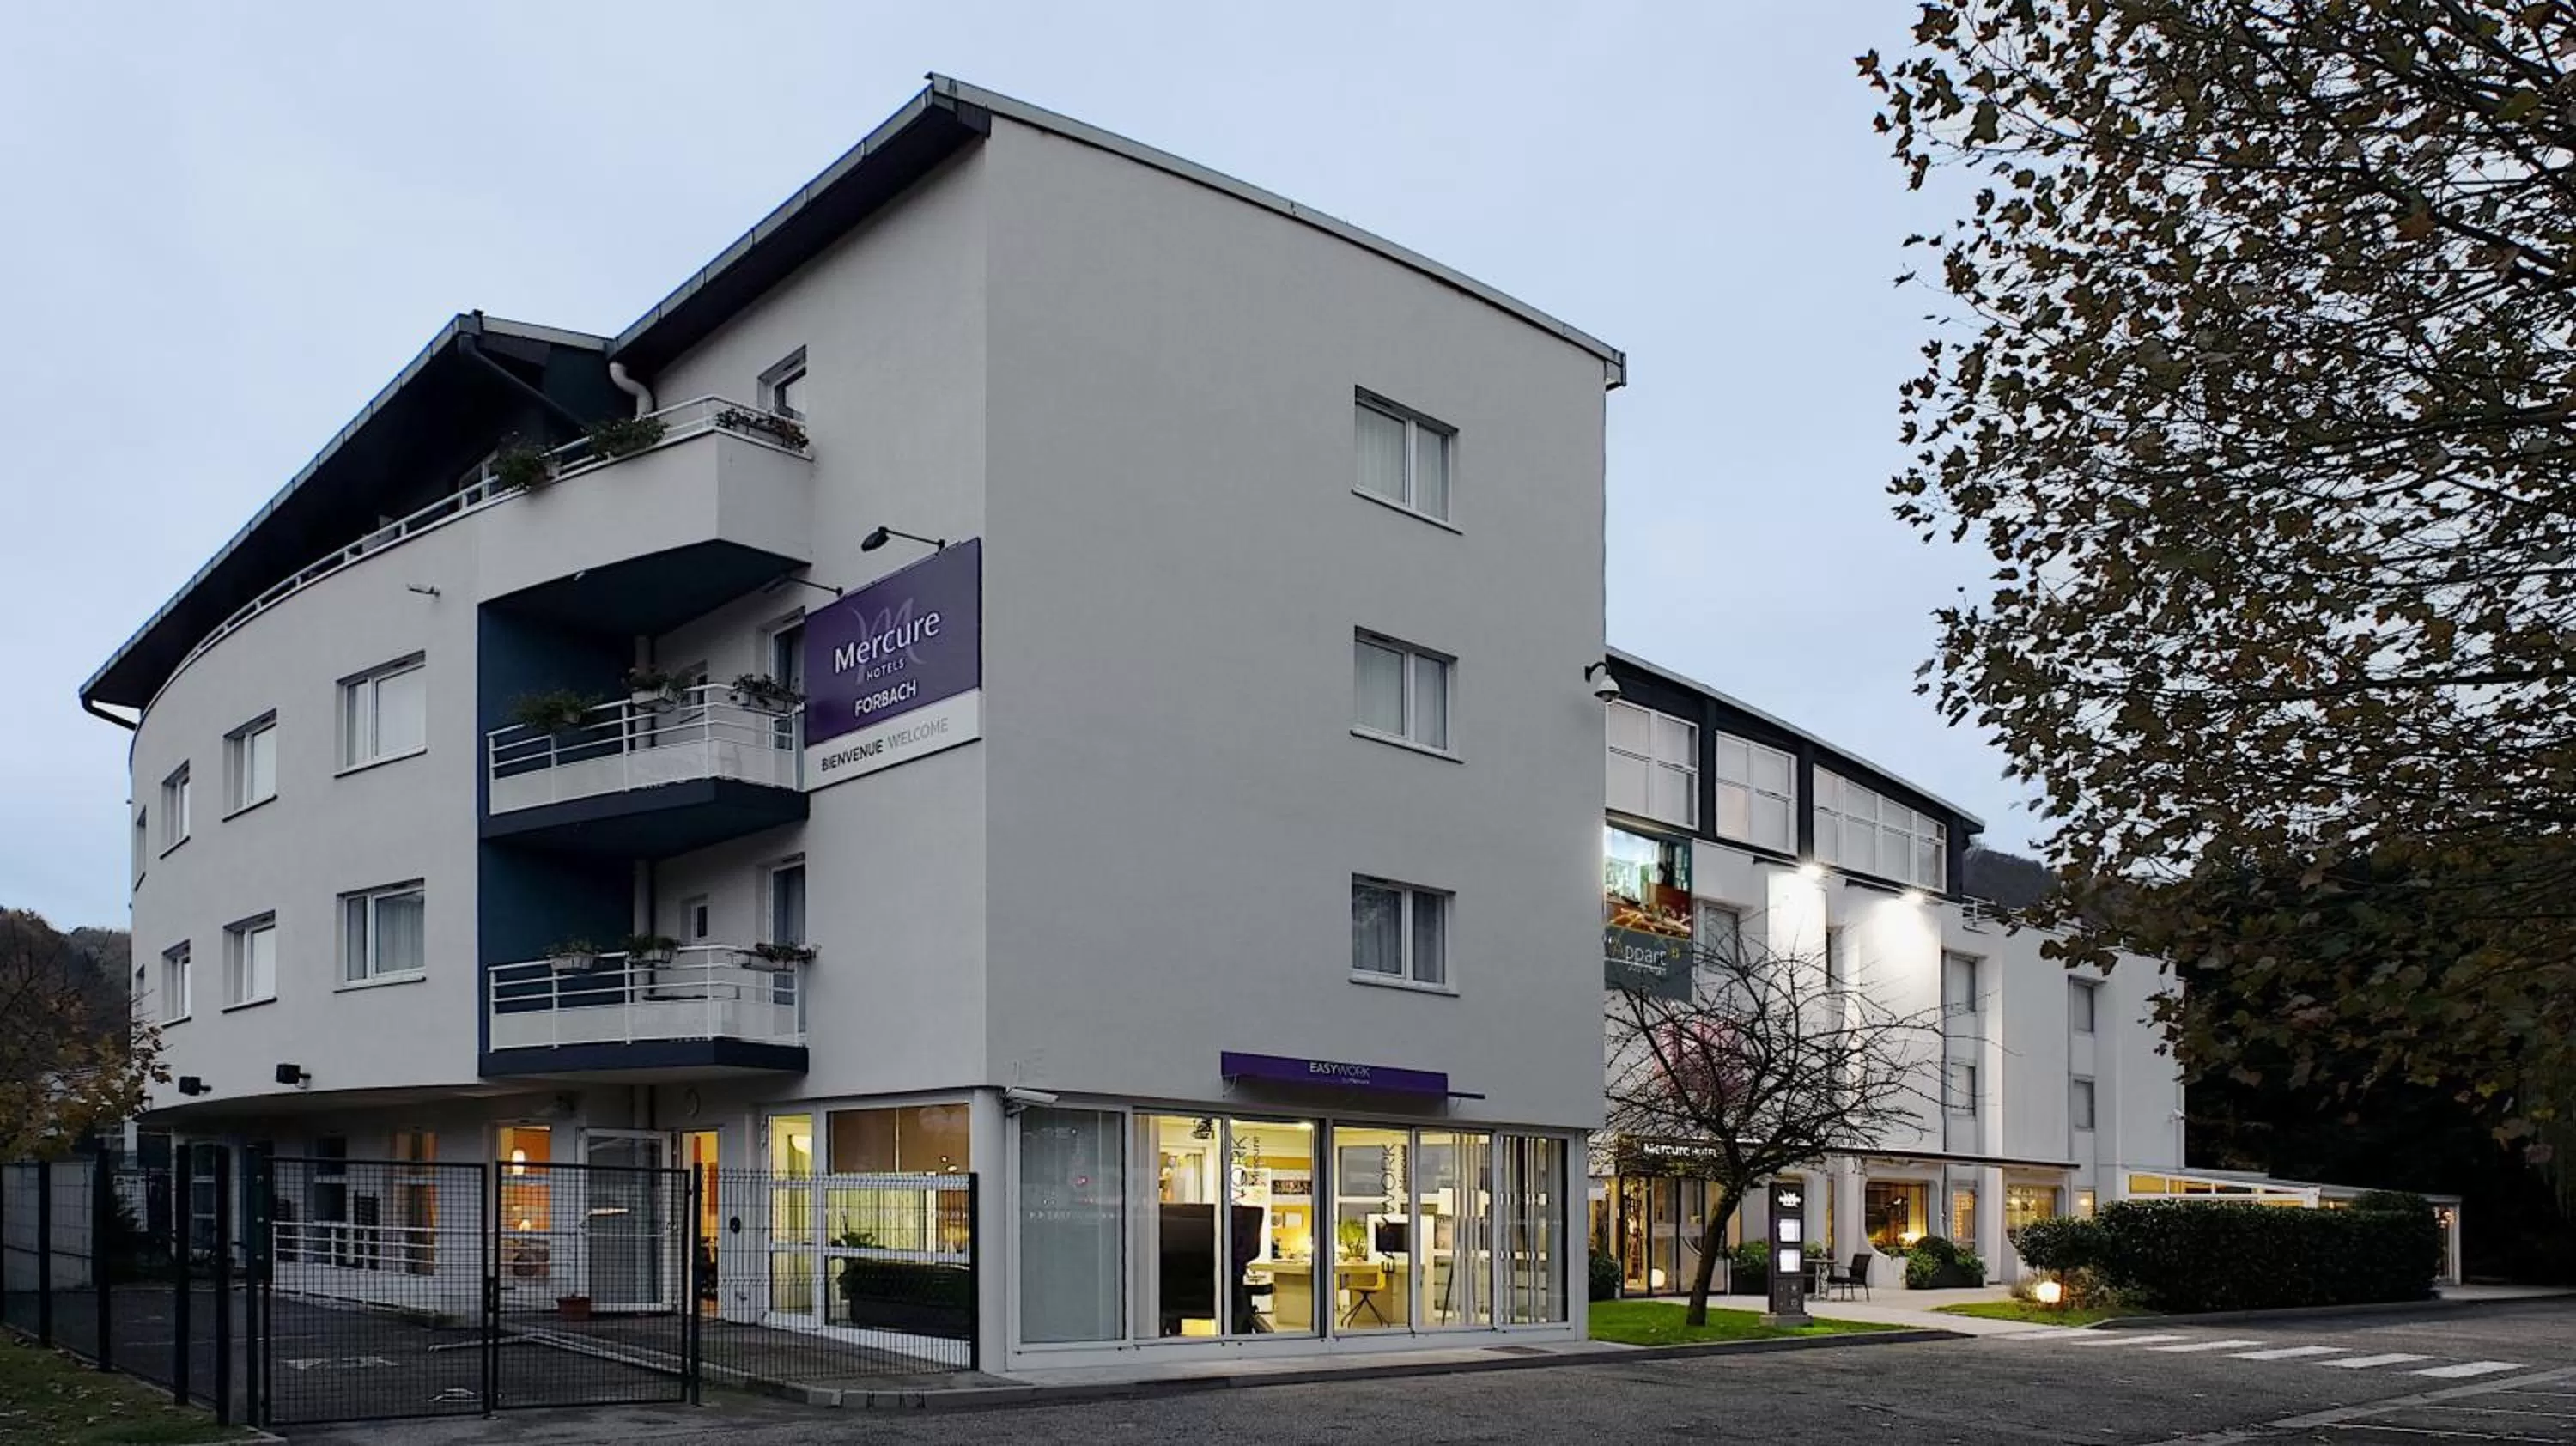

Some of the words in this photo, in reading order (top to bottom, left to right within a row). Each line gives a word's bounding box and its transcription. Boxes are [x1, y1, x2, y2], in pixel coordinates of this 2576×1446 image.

[835, 611, 941, 674] Mercure
[866, 658, 905, 681] HOTELS
[854, 679, 917, 718] FORBACH
[822, 739, 884, 772] BIENVENUE
[887, 718, 949, 749] WELCOME
[1309, 1062, 1370, 1078] EASYWORK
